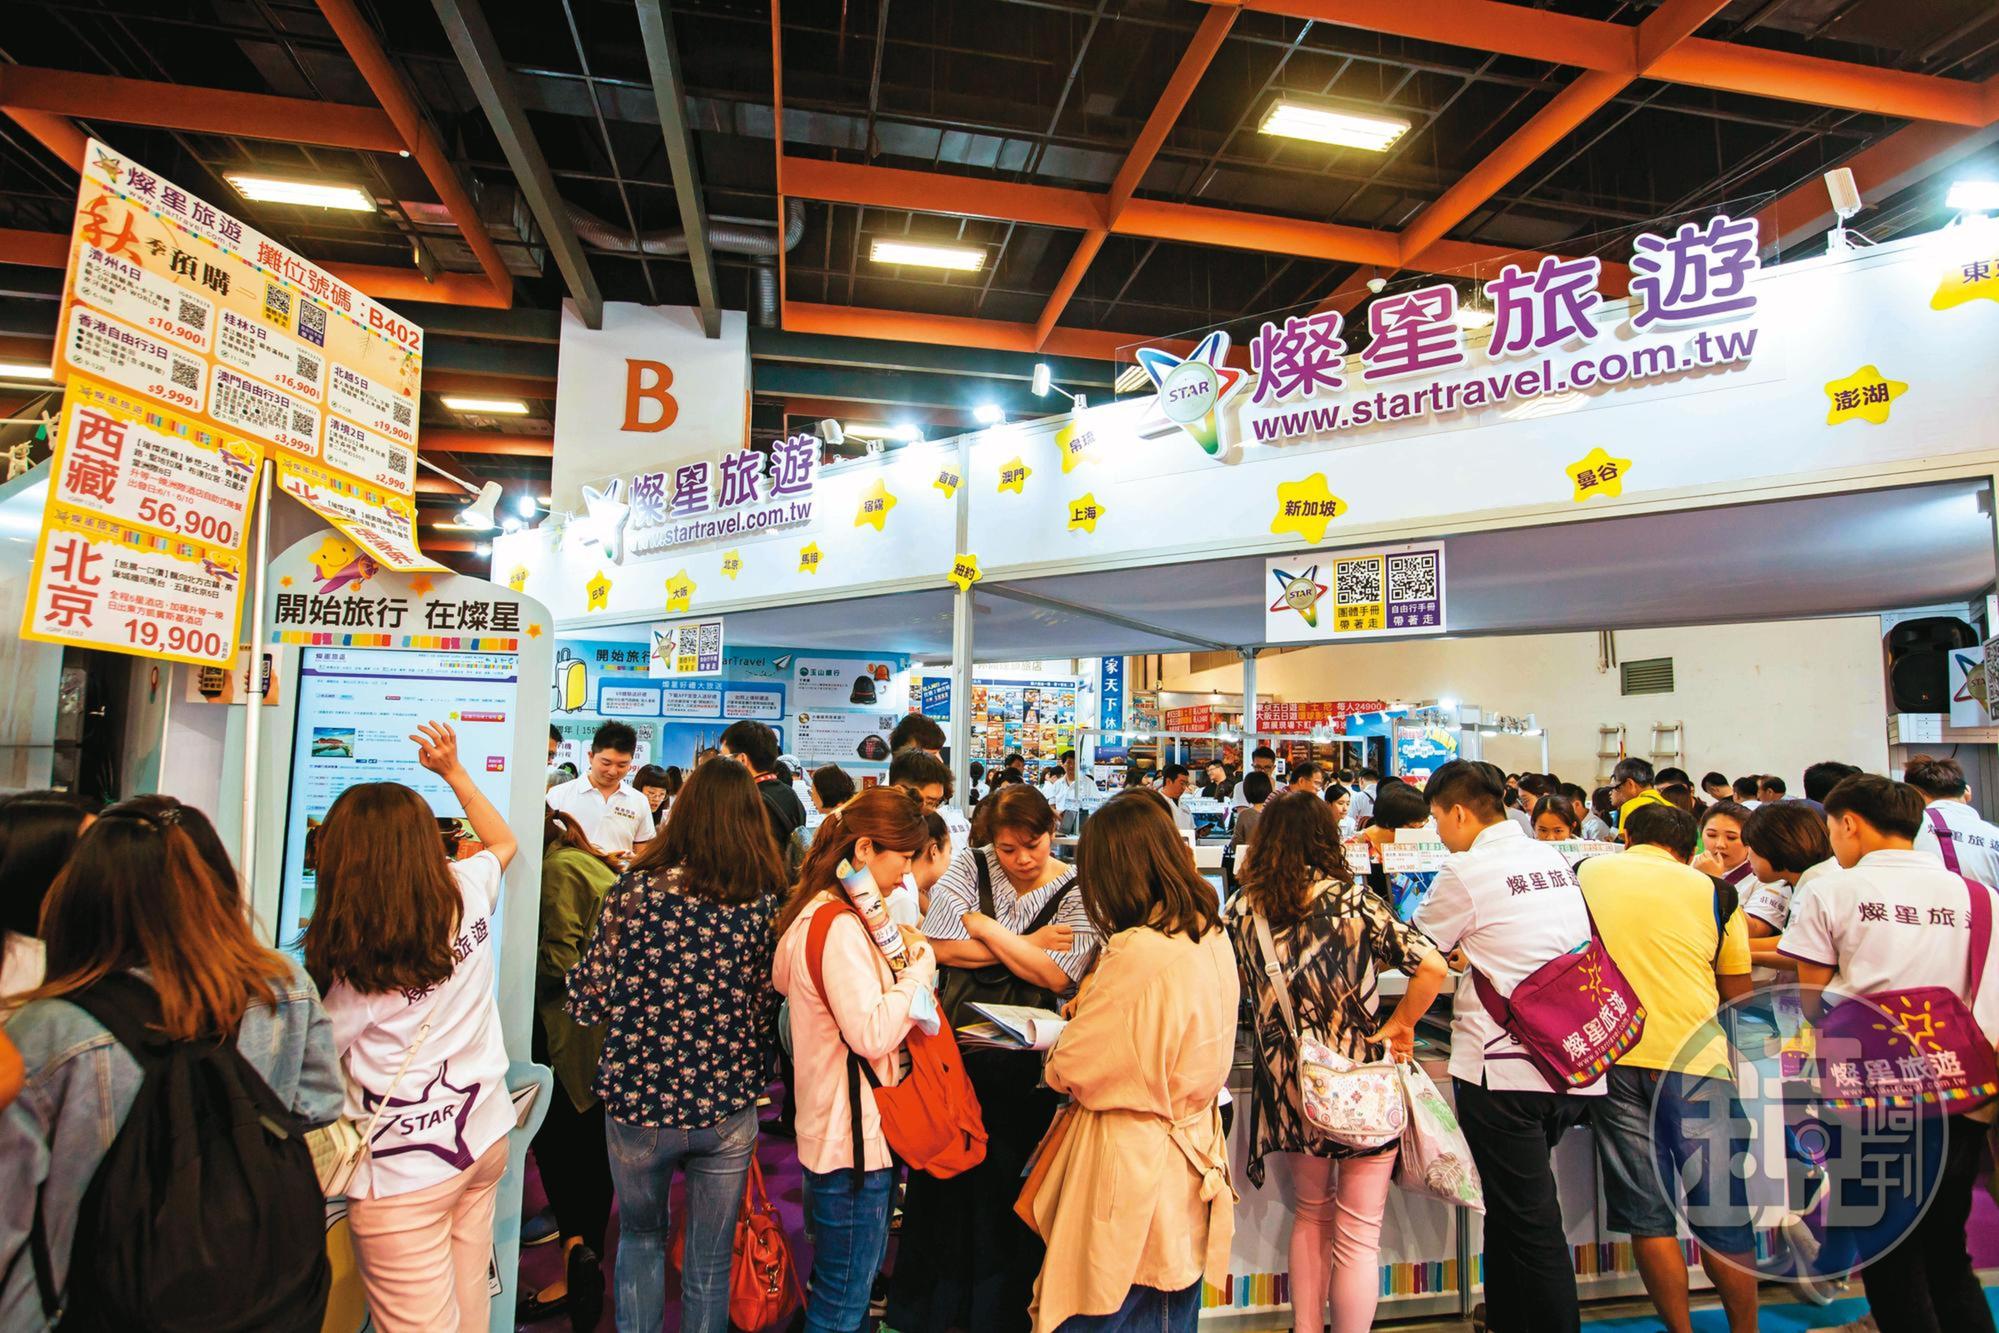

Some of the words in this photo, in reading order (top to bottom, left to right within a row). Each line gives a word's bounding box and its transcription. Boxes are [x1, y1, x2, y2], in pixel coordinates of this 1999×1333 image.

[127, 167, 242, 245] 燦星旅遊
[224, 312, 267, 340] 桂林5日
[1250, 216, 1758, 404] 燦星旅遊
[79, 313, 168, 360] 香港自由行3日
[217, 369, 290, 409] 澳門自由行3日
[620, 357, 679, 434] B
[1169, 379, 1210, 403] STAR
[1252, 334, 1758, 443] www.startravel.com.tw
[1834, 381, 1890, 414] 澎湖
[65, 409, 128, 507] 西藏
[375, 472, 406, 490] $2,990
[629, 434, 814, 521] 燦星旅遊
[1001, 467, 1025, 485] 澳門
[1576, 461, 1618, 490] 曼谷
[138, 496, 233, 545] 56,900
[1071, 505, 1097, 522] 上海
[1284, 499, 1337, 519] 新加坡
[45, 539, 103, 629] 北京
[954, 561, 977, 581] 紐約
[1289, 588, 1313, 599] STAR
[1391, 601, 1436, 615] 自由行手冊
[275, 592, 409, 629] 開始旅行
[424, 599, 520, 633] 在燦星
[1337, 603, 1380, 618] 團體手冊
[1340, 617, 1378, 630] 帶著走
[1393, 614, 1434, 628] 帶著走
[124, 618, 222, 657] 19,900
[1858, 902, 1971, 931] 燦星旅
[1562, 990, 1628, 1062] 燦星旅遊
[1830, 1050, 1967, 1088] 燦星旅遊
[400, 1103, 456, 1136] STAR
